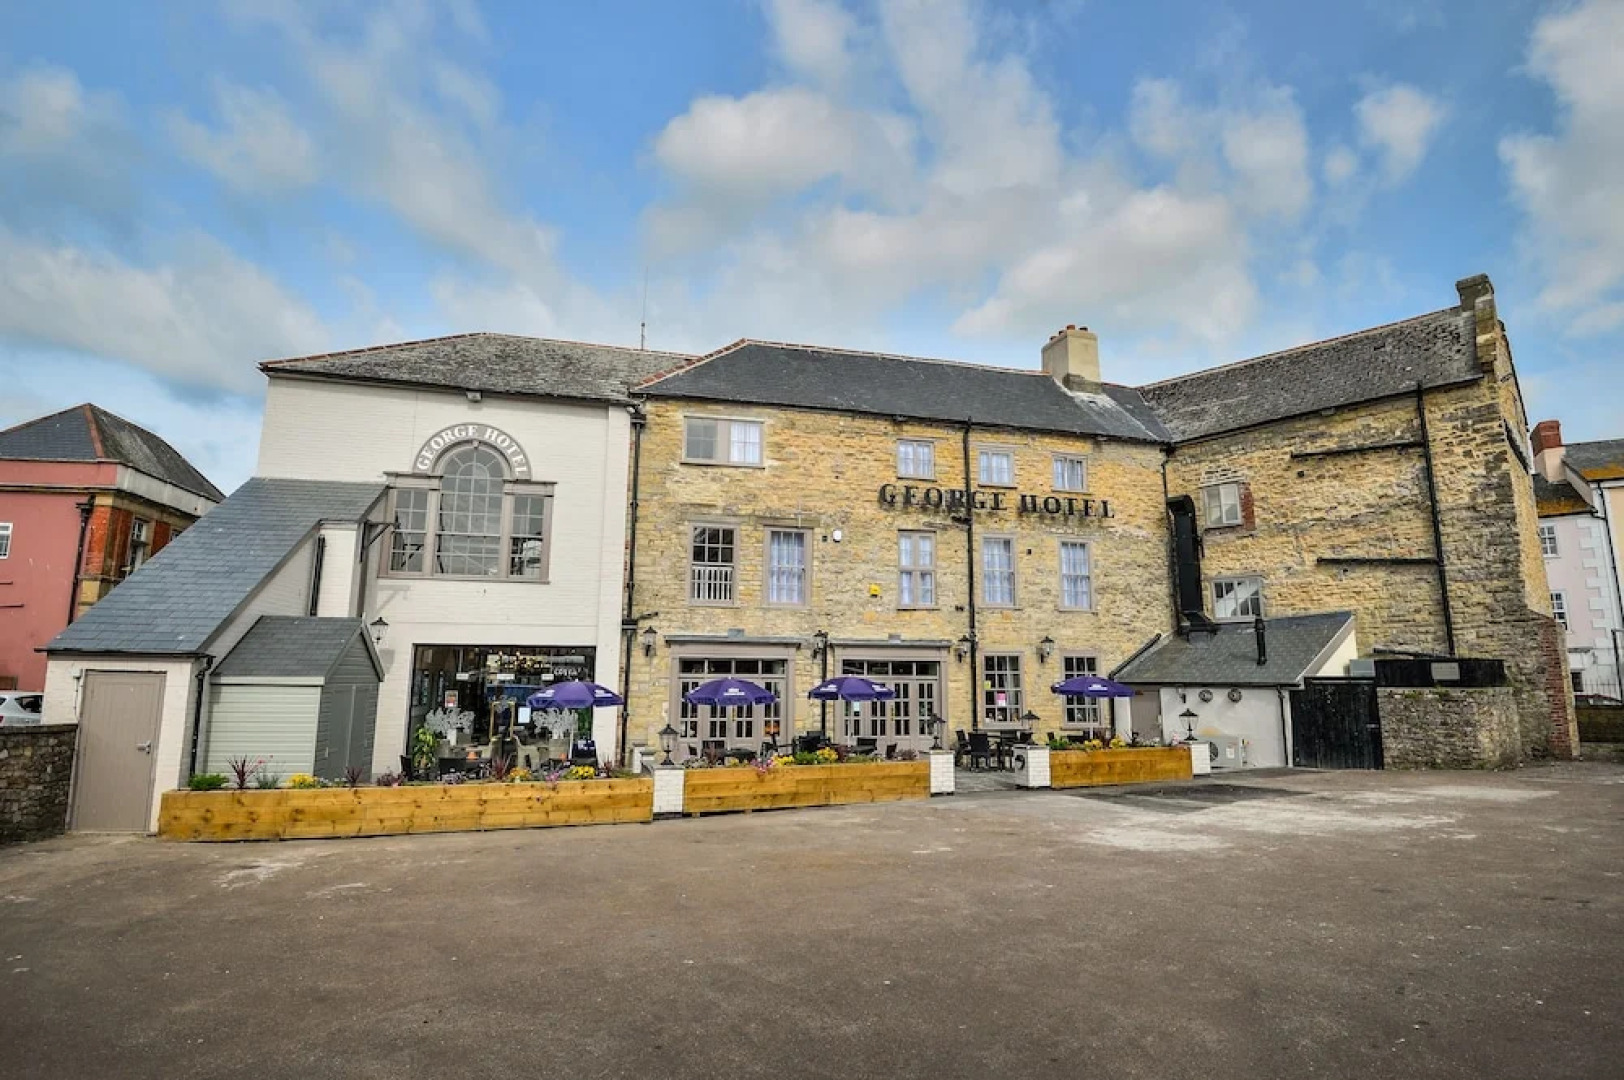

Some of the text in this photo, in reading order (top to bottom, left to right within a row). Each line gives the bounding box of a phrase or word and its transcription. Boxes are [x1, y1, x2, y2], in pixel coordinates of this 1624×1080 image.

[417, 425, 528, 475] GEORGE HOTEL
[878, 483, 1115, 519] GEORGE HOTEL
